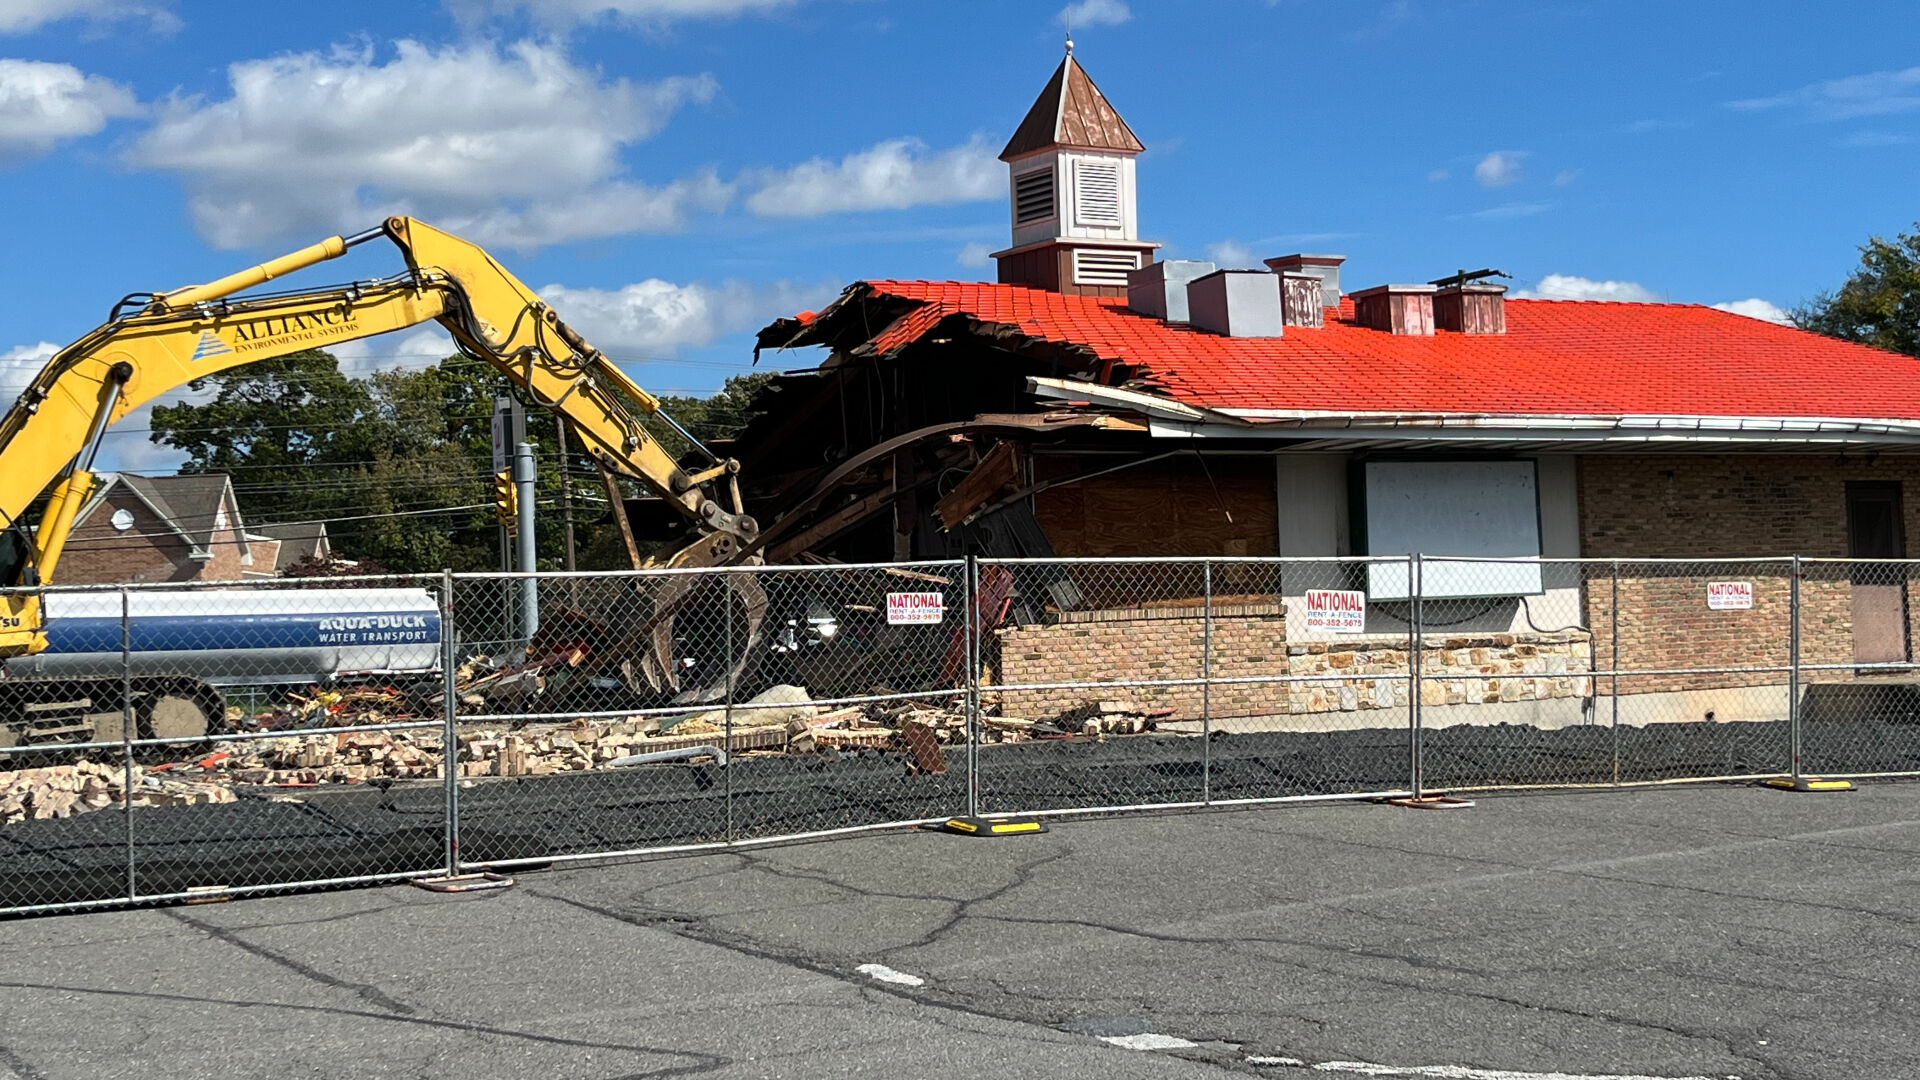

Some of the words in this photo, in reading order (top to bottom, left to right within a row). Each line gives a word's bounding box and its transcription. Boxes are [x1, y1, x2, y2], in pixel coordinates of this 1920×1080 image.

[233, 308, 357, 343] ALLIANCE
[235, 333, 315, 354] ENVIRONMENTAL
[318, 323, 359, 338] SYSTEMS
[1709, 583, 1750, 596] NATIONAL
[889, 594, 941, 608] NATIONAL
[1307, 592, 1363, 611] NATIONAL
[319, 615, 427, 631] AQUA-DUCK
[319, 633, 356, 643] WATER
[362, 631, 427, 641] TRANSPORT
